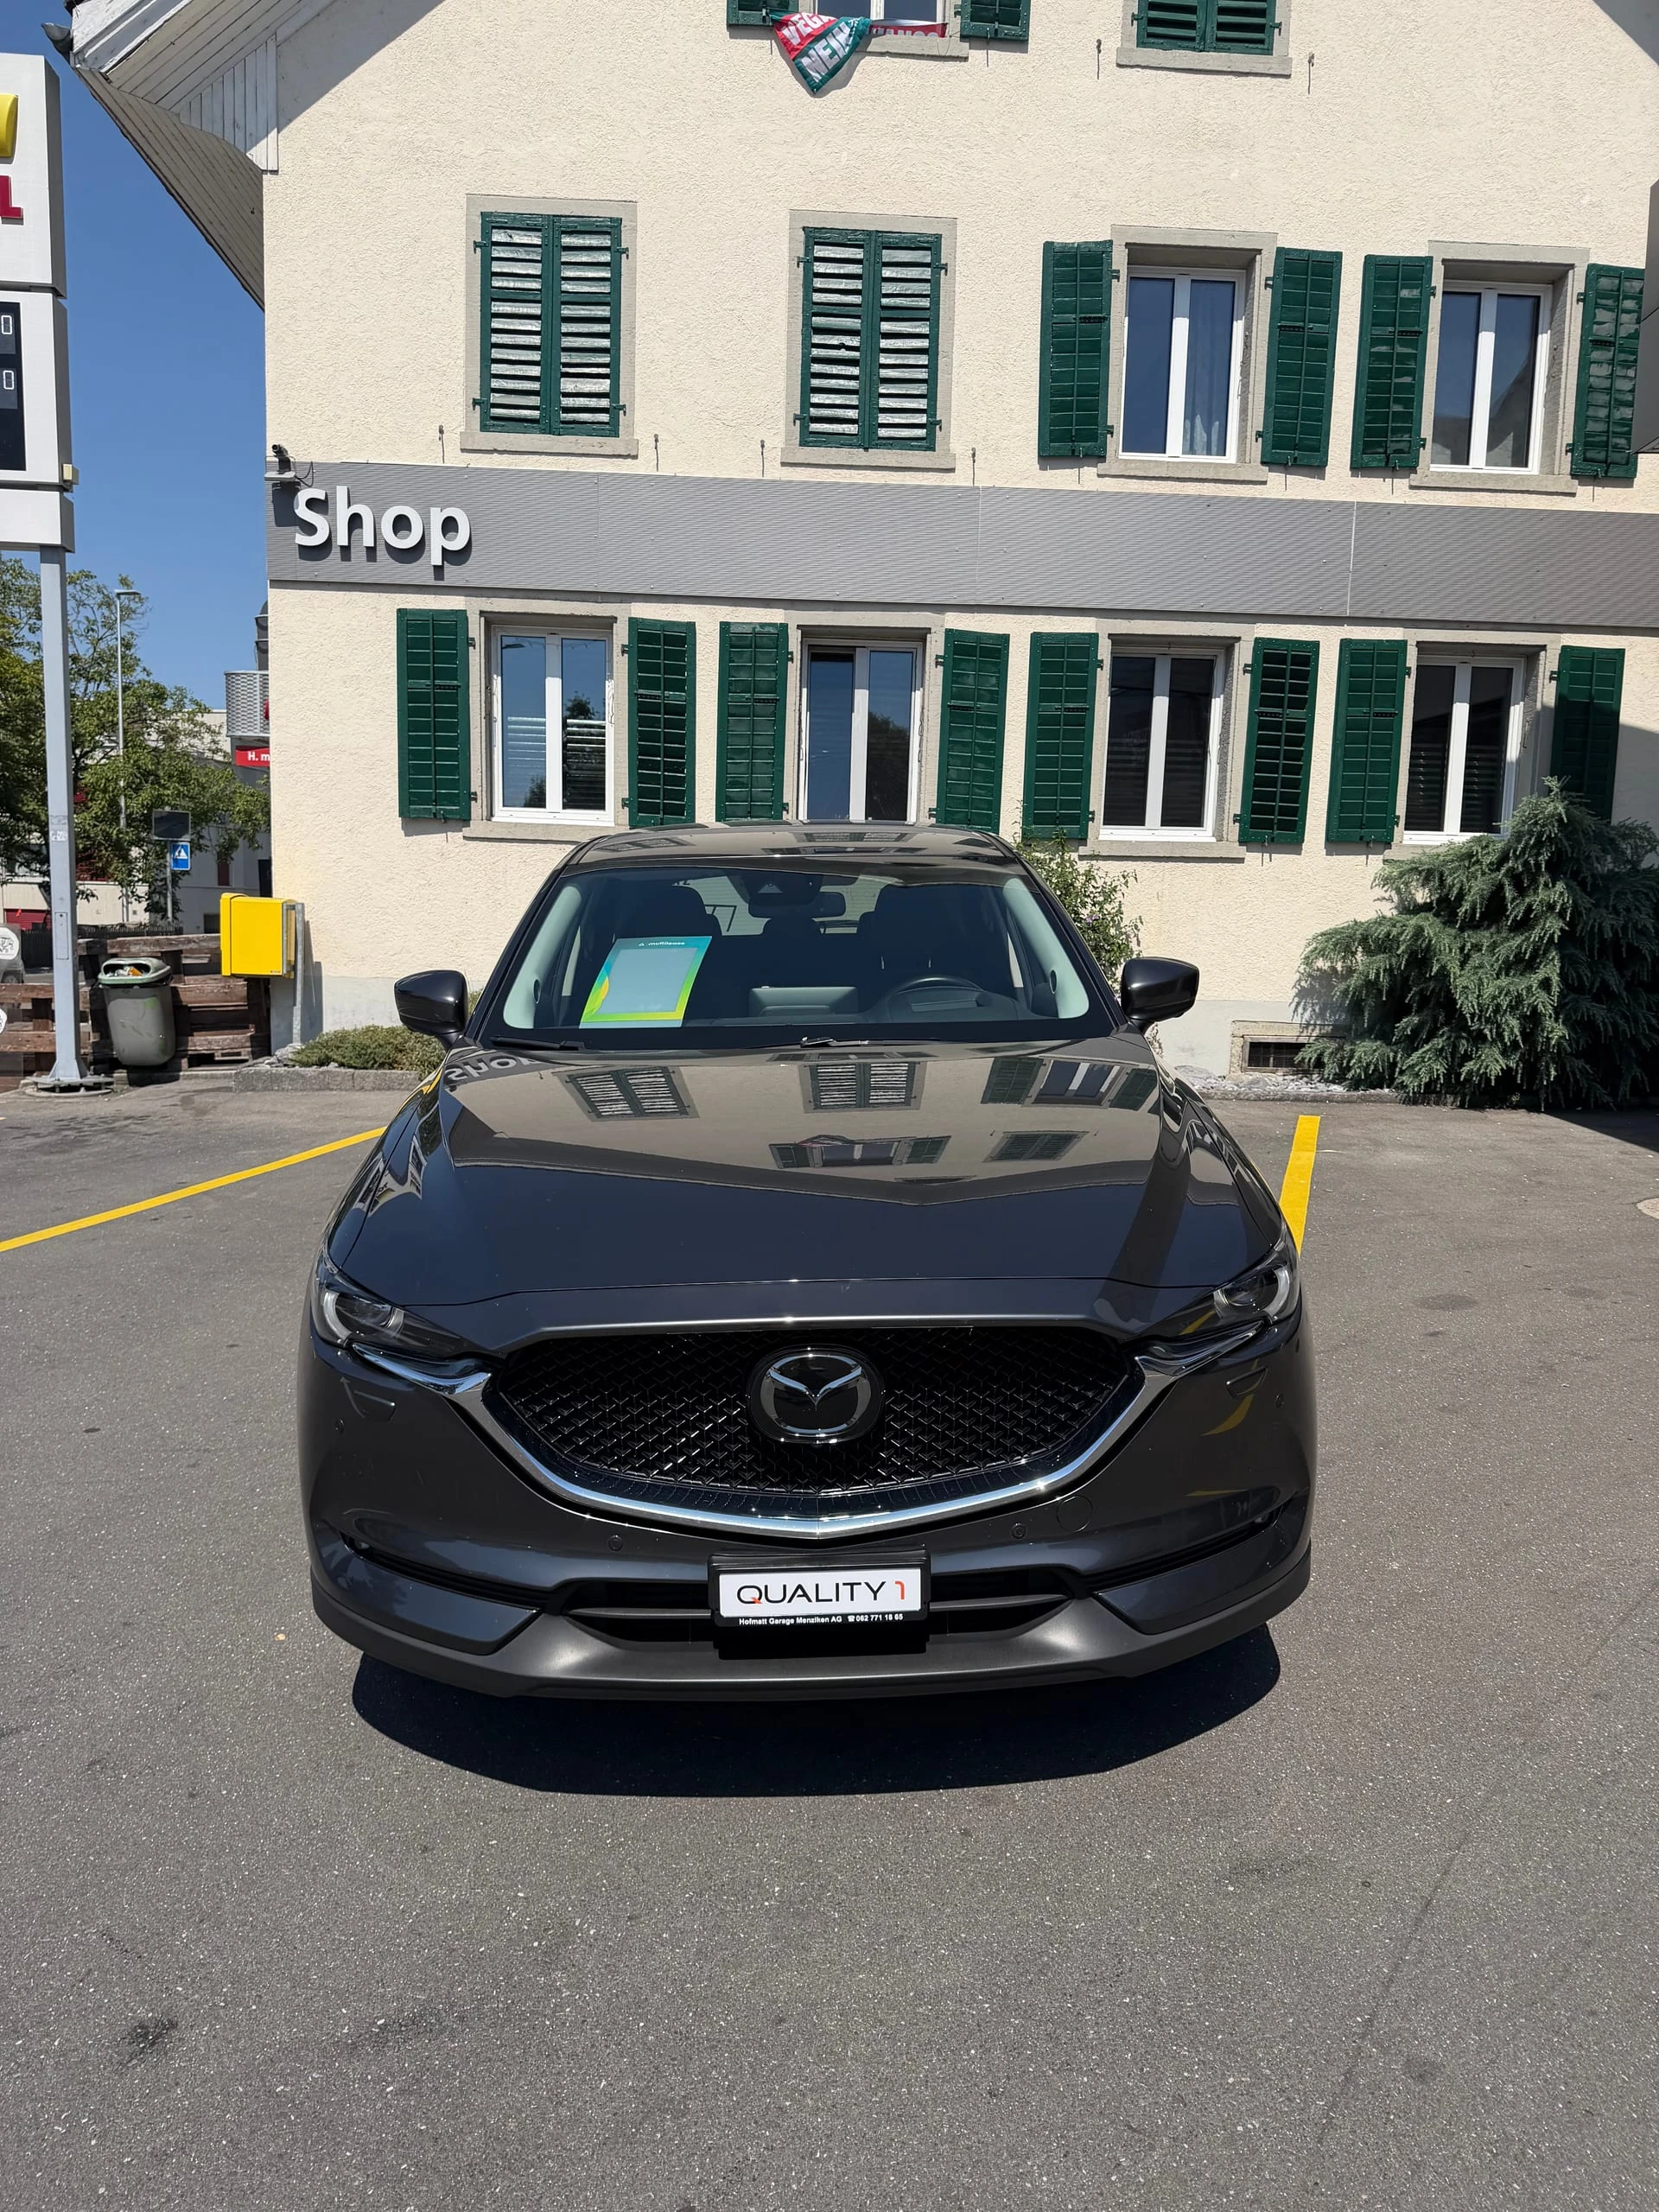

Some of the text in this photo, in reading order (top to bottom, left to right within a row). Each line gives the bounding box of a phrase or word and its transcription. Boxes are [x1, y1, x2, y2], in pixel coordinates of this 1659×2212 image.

[801, 22, 850, 82] NEIN
[294, 486, 470, 566] Shop
[247, 751, 258, 761] H.
[736, 1581, 887, 1605] QUALITY
[769, 1617, 794, 1625] Garage
[796, 1616, 830, 1624] Menziken
